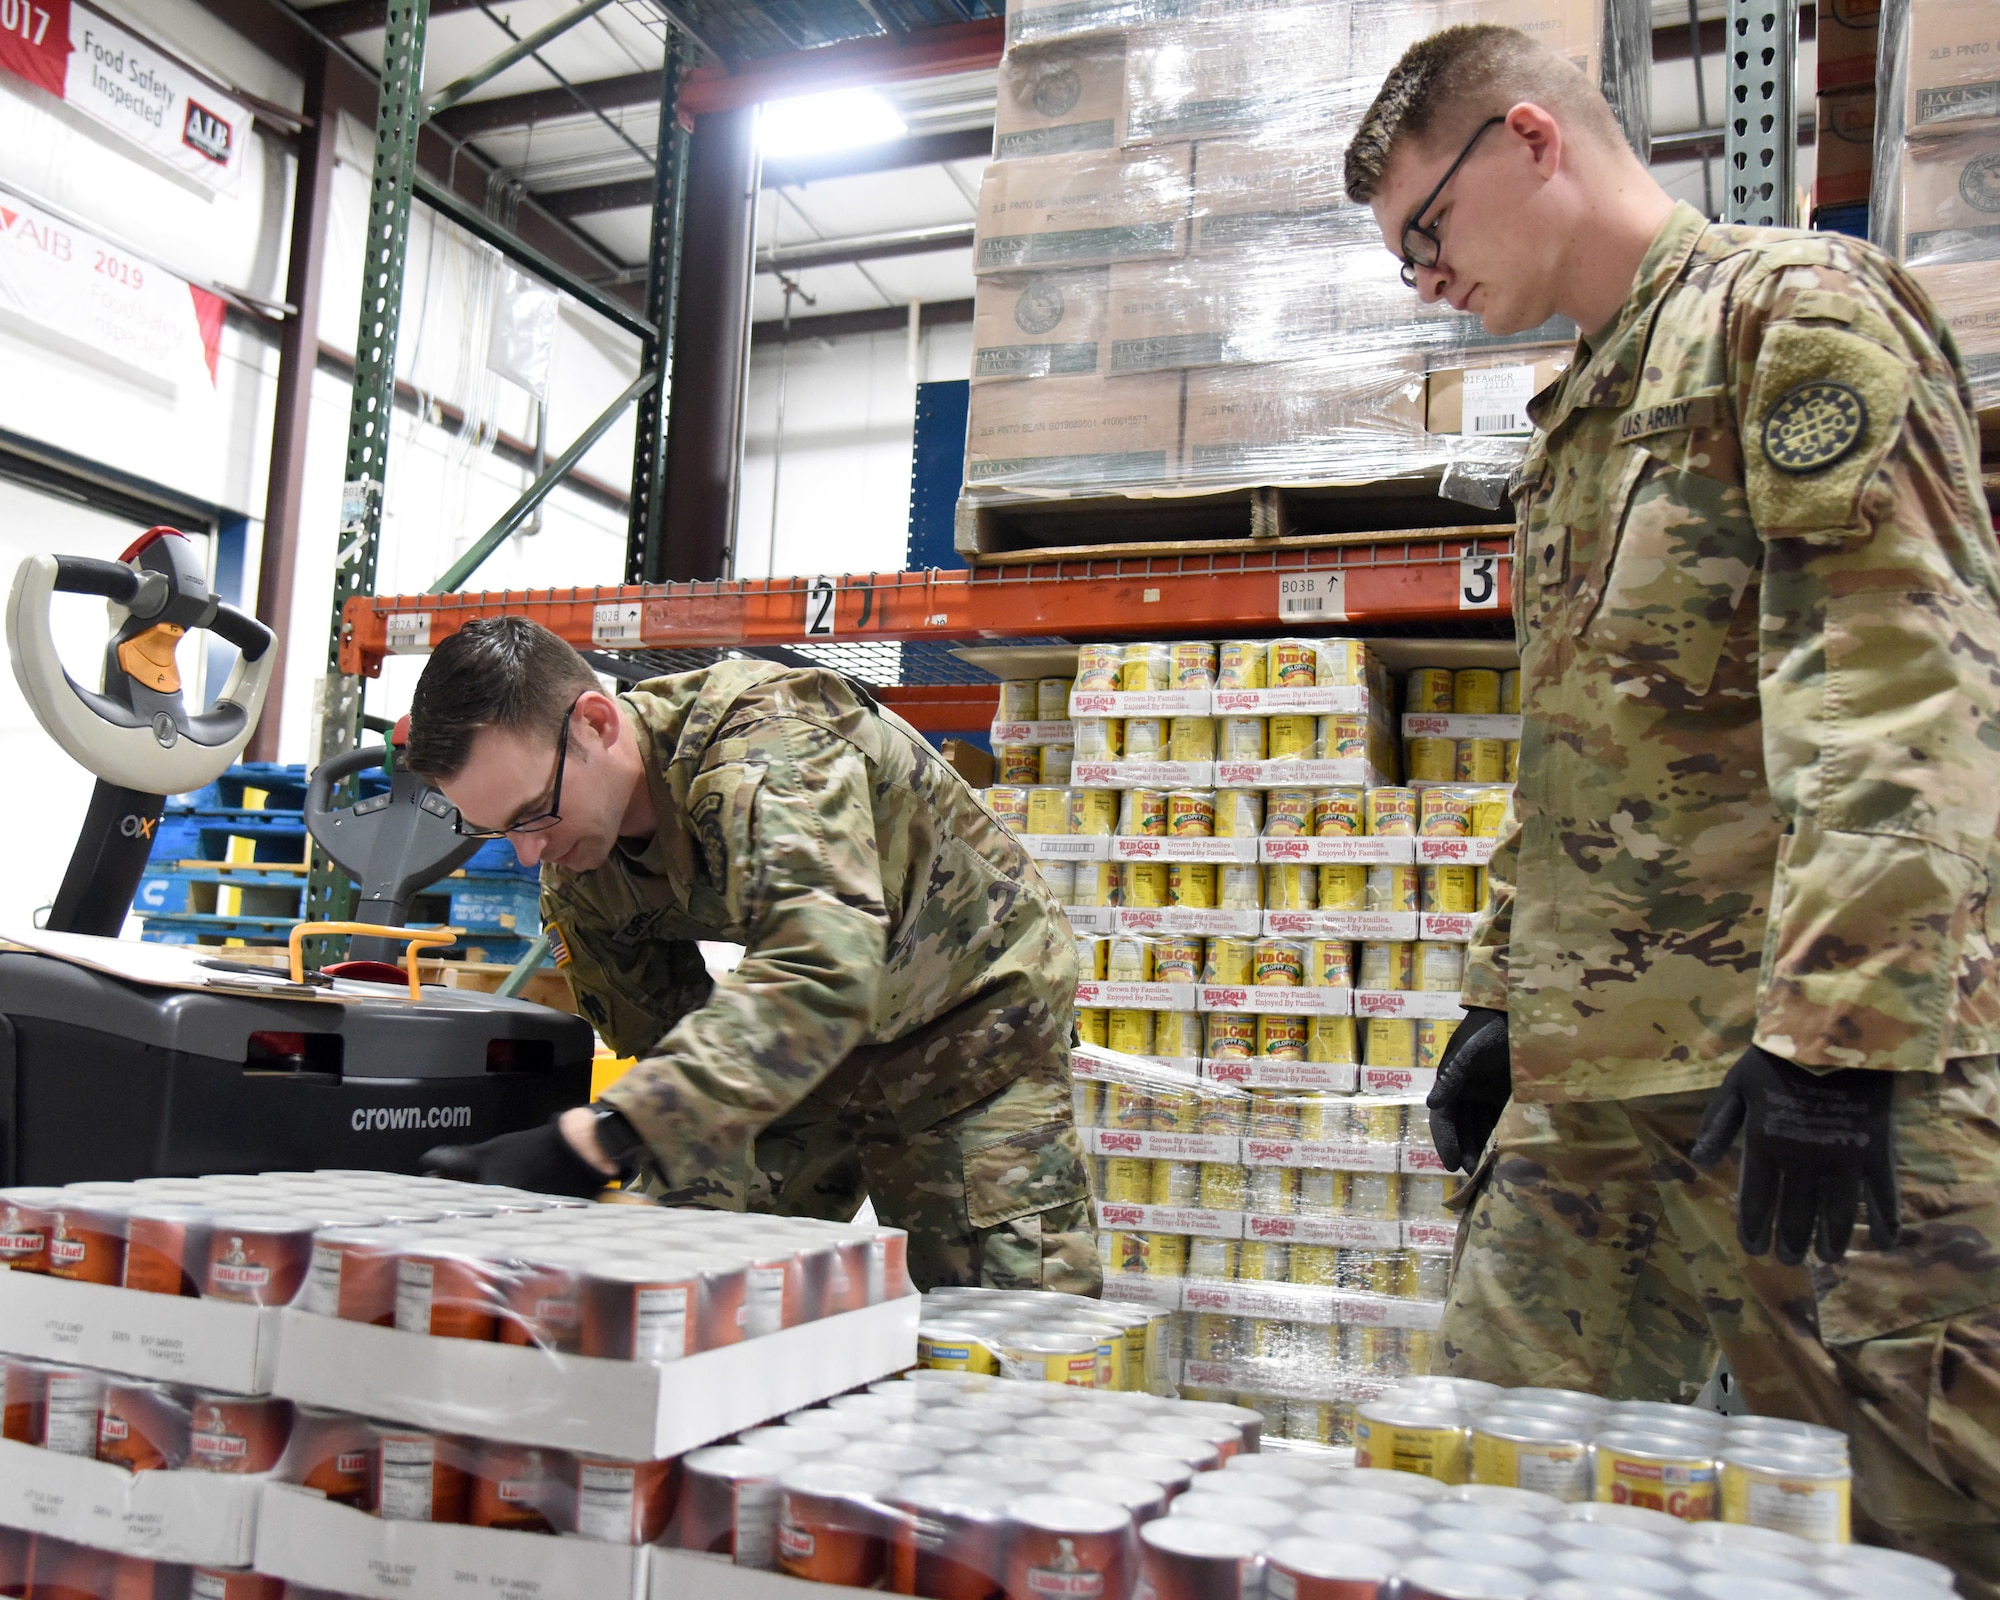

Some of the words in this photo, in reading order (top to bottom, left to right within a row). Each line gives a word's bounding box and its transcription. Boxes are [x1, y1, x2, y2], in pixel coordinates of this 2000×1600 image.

[1930, 48, 1950, 60] 2LB
[1957, 43, 1990, 56] PINTO
[84, 31, 124, 77] Food
[128, 59, 175, 114] Safety
[92, 66, 164, 128] Inspected
[1010, 201, 1033, 210] PINTO
[16, 219, 73, 263] AIB
[94, 250, 145, 291] 2019
[1622, 414, 1641, 438] U.S.
[1647, 402, 1691, 431] ARMY
[997, 424, 1020, 434] PINTO
[1022, 422, 1046, 432] BEAN
[1463, 547, 1493, 604] 3
[1282, 579, 1315, 593] B03B
[809, 582, 833, 634] 2
[1277, 653, 1299, 664] RED
[1075, 697, 1092, 705] RED
[1093, 695, 1116, 705] GOLD
[1217, 695, 1235, 705] RED
[1236, 694, 1259, 703] GOLD
[1077, 766, 1093, 776] RED
[1094, 765, 1117, 775] GOLD
[1278, 802, 1306, 813] GOLD
[1330, 802, 1357, 813] GOLD
[1375, 802, 1396, 813] RED
[1119, 841, 1136, 850] RED
[1137, 841, 1160, 850] GOLD
[1266, 843, 1283, 852] RED
[1285, 842, 1309, 852] GOLD
[1422, 843, 1441, 852] RED
[1442, 842, 1467, 852] GOLD
[1446, 918, 1472, 927] GOLD
[1257, 953, 1275, 963] RED
[1323, 954, 1343, 964] RED
[1131, 986, 1139, 994] By
[1204, 991, 1221, 1000] RED
[1223, 990, 1247, 1000] GOLD
[1281, 991, 1290, 999] By
[1107, 994, 1134, 1002] Enjoyed
[1360, 995, 1379, 1005] RED
[1381, 995, 1405, 1005] GOLD
[1255, 1000, 1283, 1008] Enjoyed
[1285, 1000, 1293, 1008] By
[1230, 1026, 1254, 1037] GOLD
[1266, 1028, 1286, 1038] RED
[1227, 1065, 1252, 1075] GOLD
[1367, 1072, 1385, 1081] RED
[1387, 1072, 1412, 1082] GOLD
[352, 1105, 471, 1131] crown.com
[1101, 1134, 1118, 1144] RED
[1120, 1135, 1142, 1145] GOLD
[1301, 1154, 1329, 1162] Enjoyed
[1332, 1155, 1341, 1163] By
[1103, 1206, 1120, 1216] RED
[1121, 1207, 1144, 1217] GOLD
[1153, 1218, 1180, 1226] Enjoyed
[1182, 1219, 1190, 1227] By
[15, 1236, 42, 1248] Chef
[62, 1244, 82, 1257] Chef
[215, 1267, 237, 1281] Little
[239, 1270, 267, 1284] Chef
[106, 1421, 126, 1436] Chef
[218, 1440, 244, 1454] Chef
